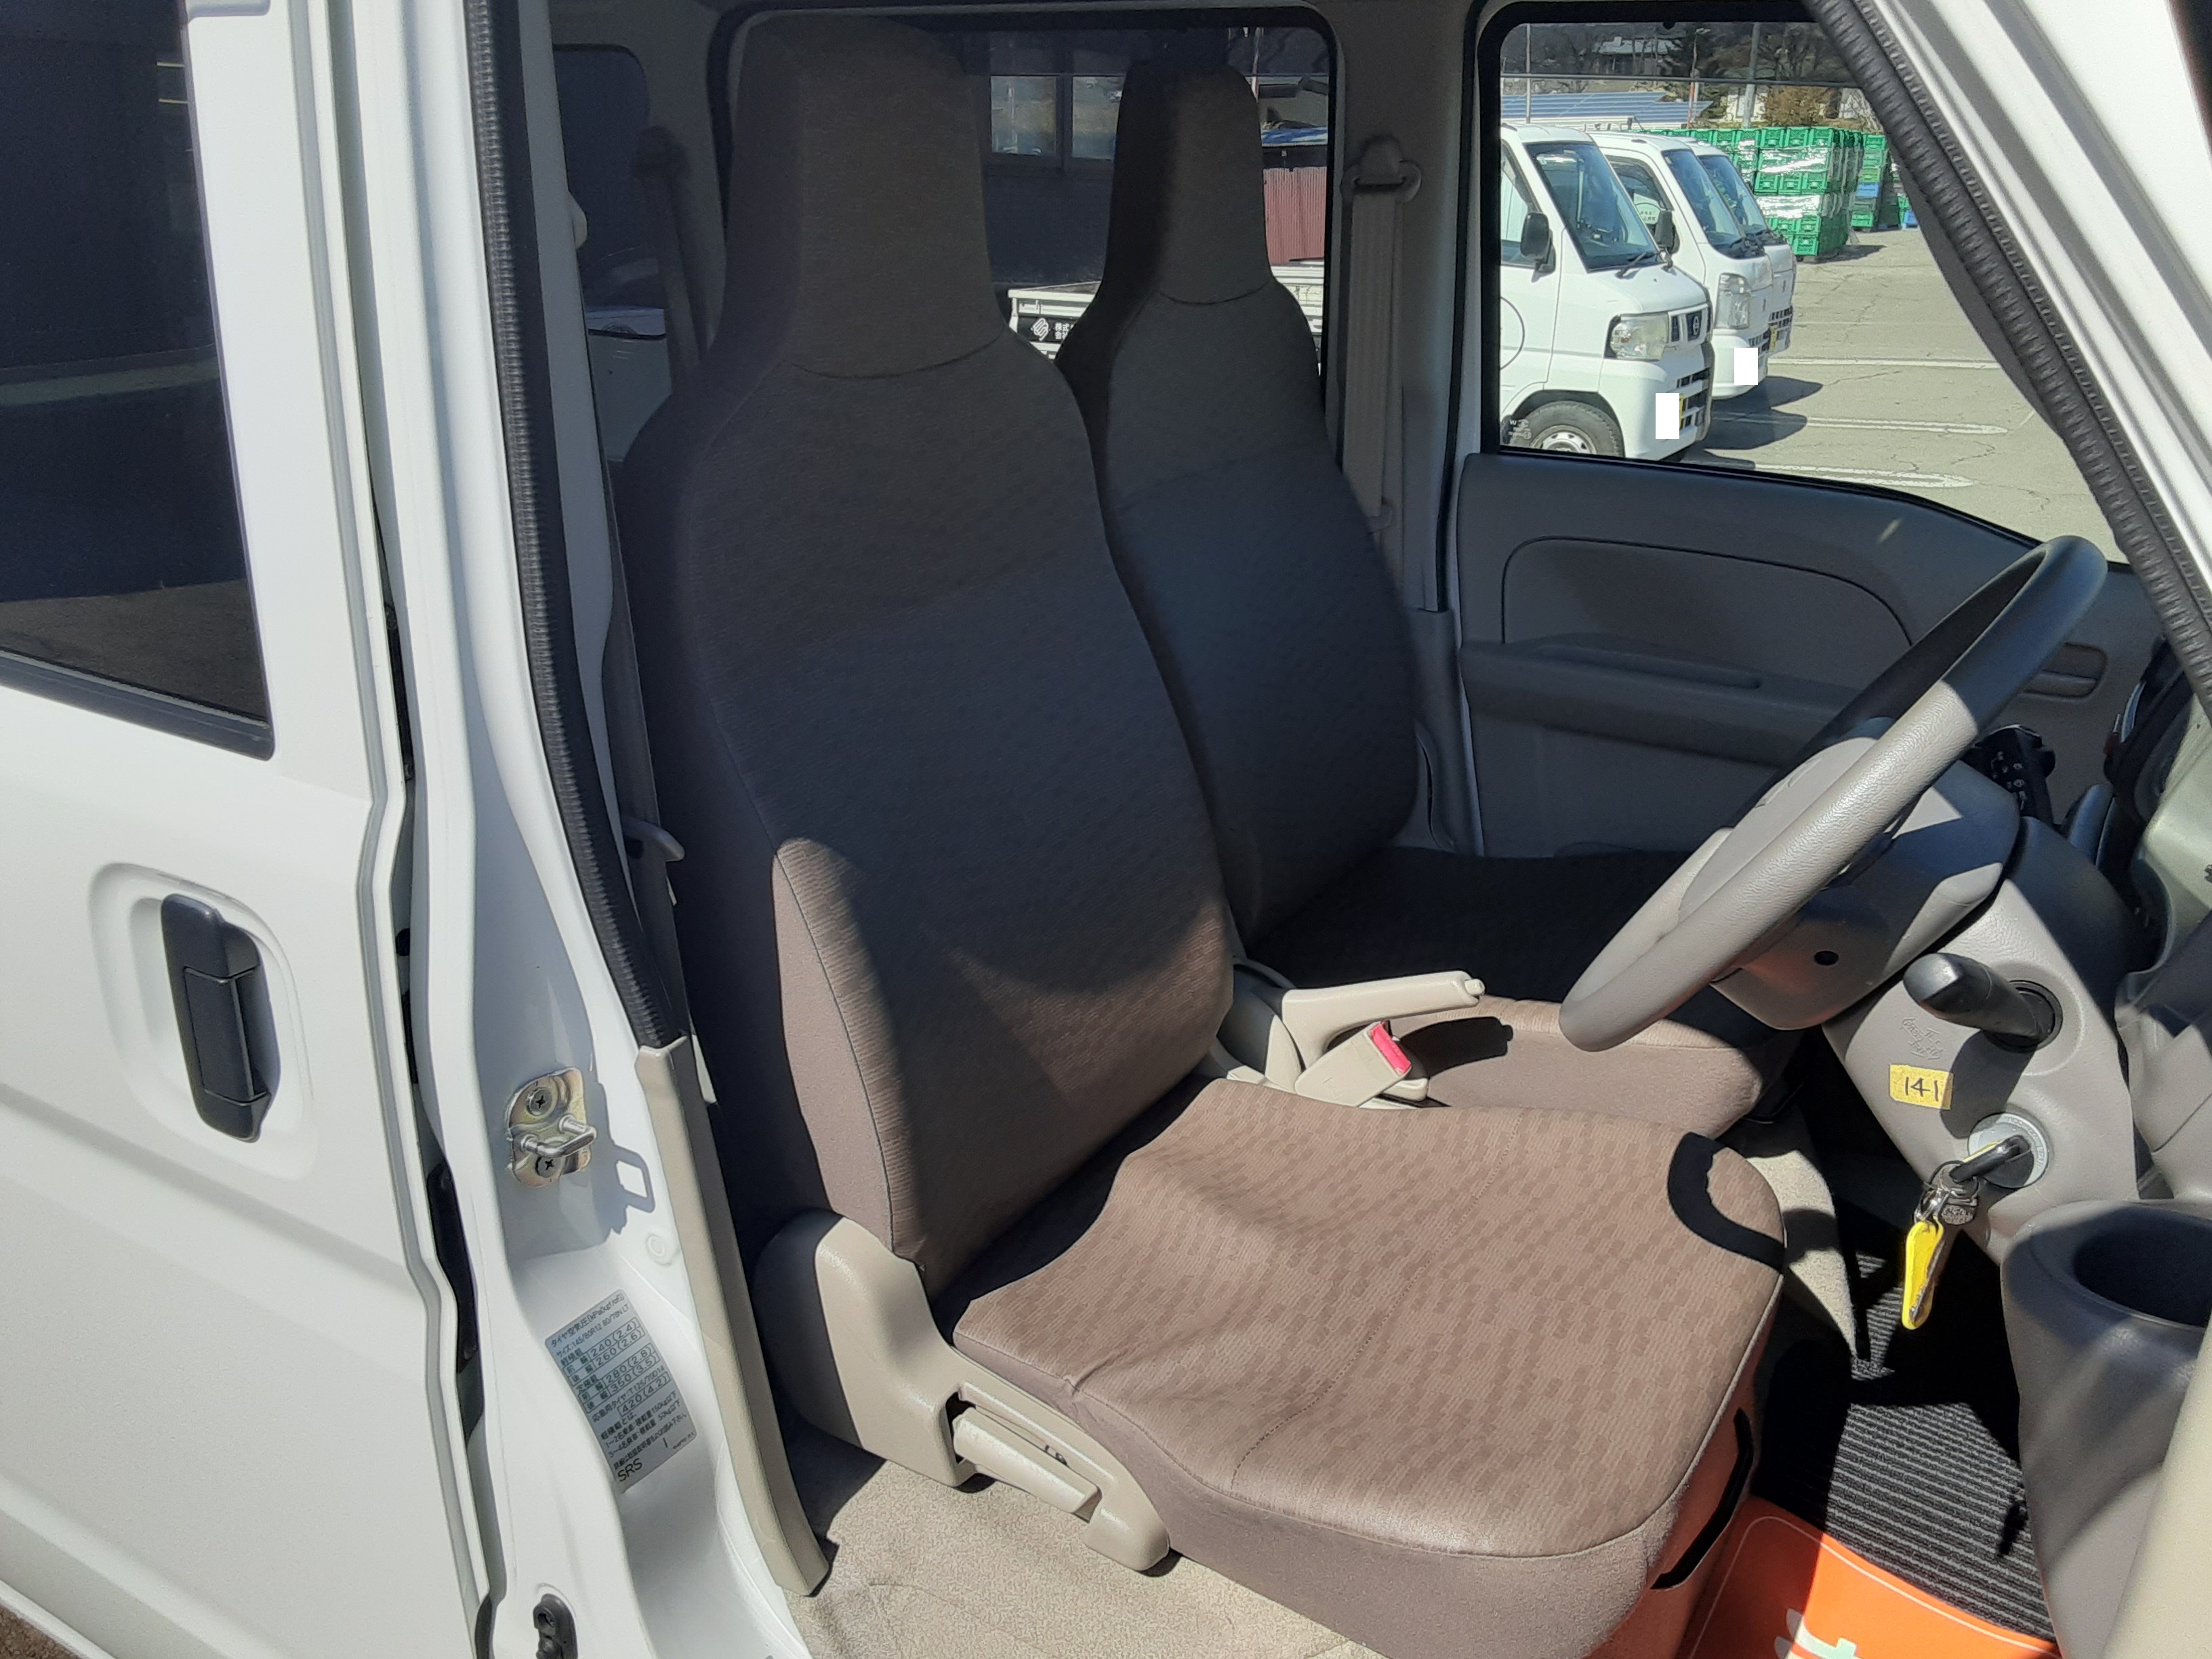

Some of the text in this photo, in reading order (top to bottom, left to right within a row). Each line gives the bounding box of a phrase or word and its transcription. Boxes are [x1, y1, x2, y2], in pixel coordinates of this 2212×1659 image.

[1904, 1076, 1940, 1103] 141
[622, 1375, 670, 1412] 420(4.2)
[617, 1457, 642, 1482] SRS
